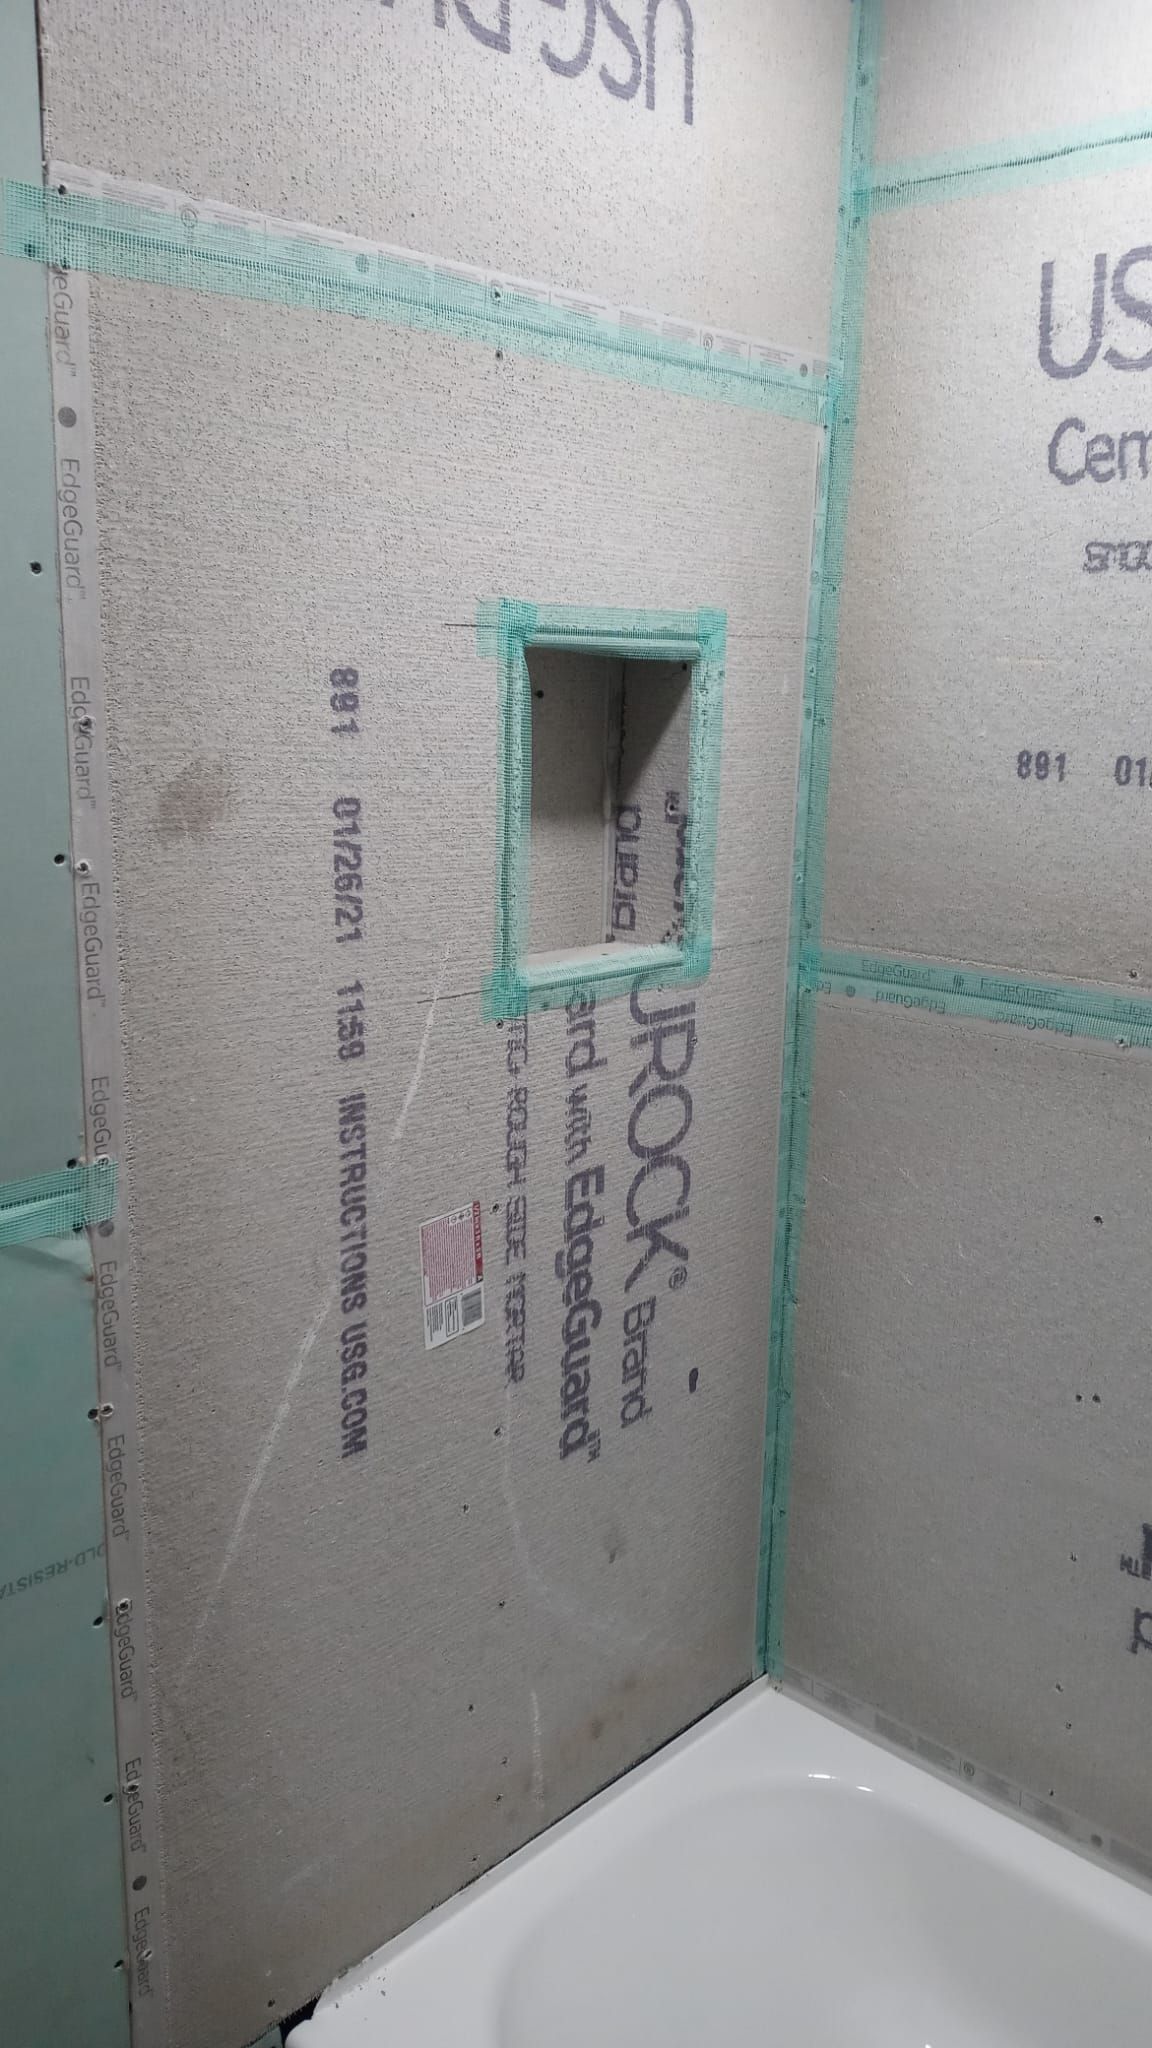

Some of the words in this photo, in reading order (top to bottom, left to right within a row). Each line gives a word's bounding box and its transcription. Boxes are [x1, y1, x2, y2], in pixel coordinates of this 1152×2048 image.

[564, 1083, 593, 1167] with
[338, 1092, 368, 1315] INSTRUCTIONS
[339, 1320, 369, 1459] USG.COM
[620, 1295, 656, 1431] Brand
